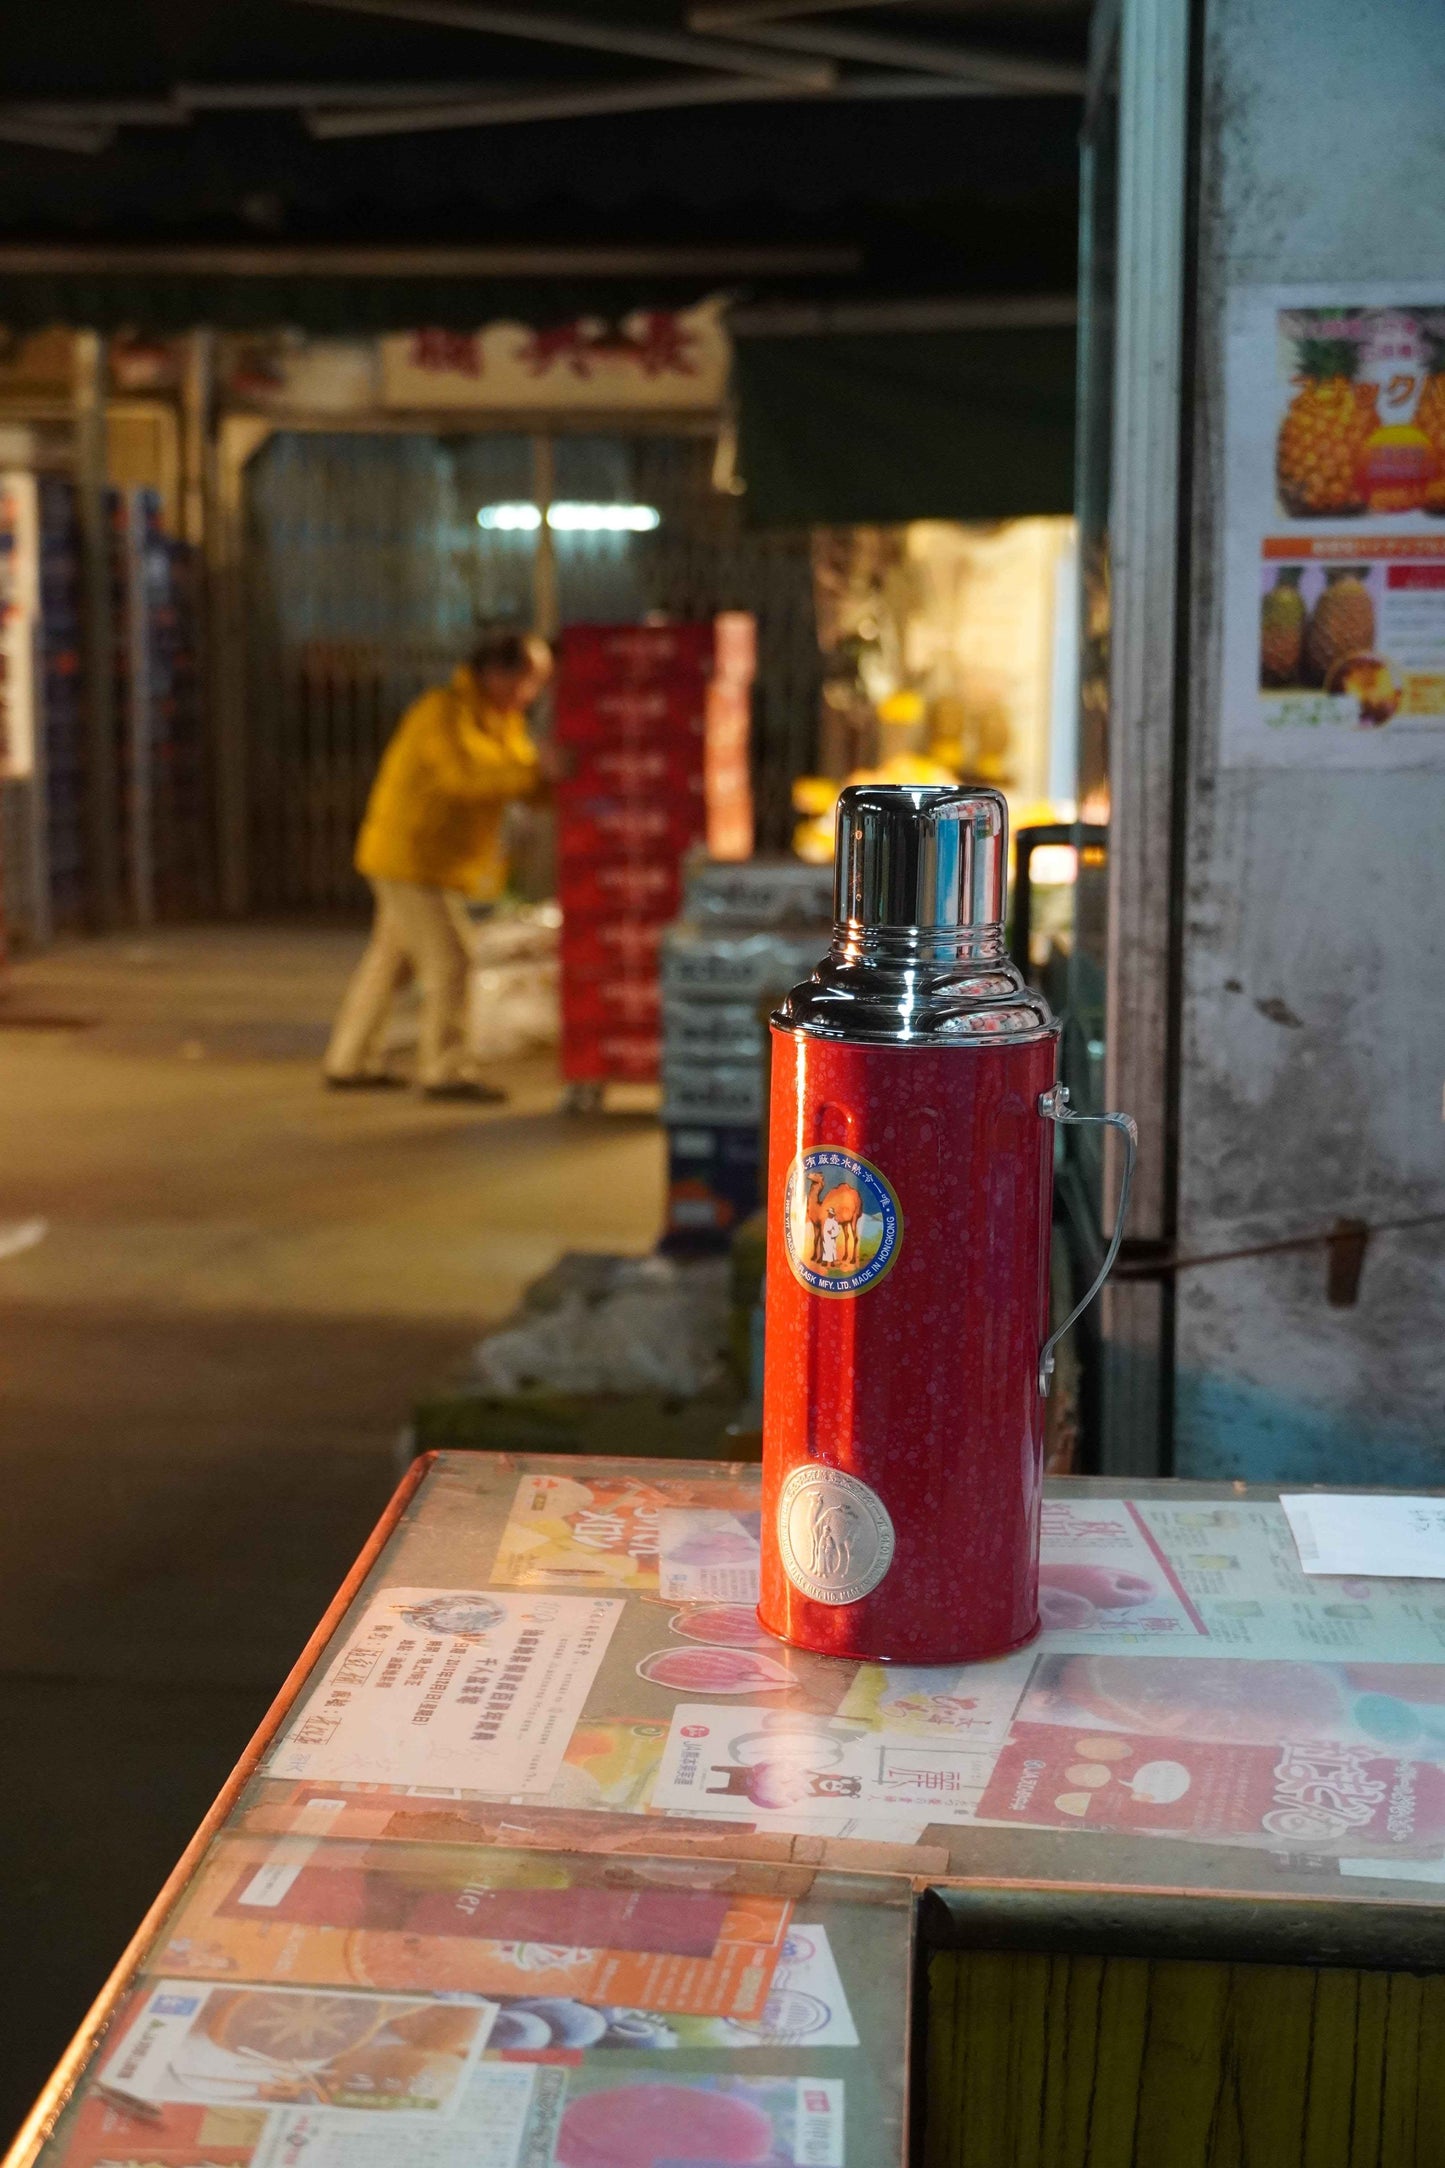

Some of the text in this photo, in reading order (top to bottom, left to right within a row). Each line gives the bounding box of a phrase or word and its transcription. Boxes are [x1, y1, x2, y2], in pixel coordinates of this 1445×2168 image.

[798, 1264, 816, 1284] FLASK
[818, 1278, 835, 1290] MFY.
[837, 1281, 852, 1290] LTD.
[852, 1270, 874, 1287] MADE
[873, 1263, 882, 1273] IN
[879, 1216, 895, 1263] HONGKONG
[572, 1509, 627, 1549] メロン
[888, 1766, 961, 1791] 麗
